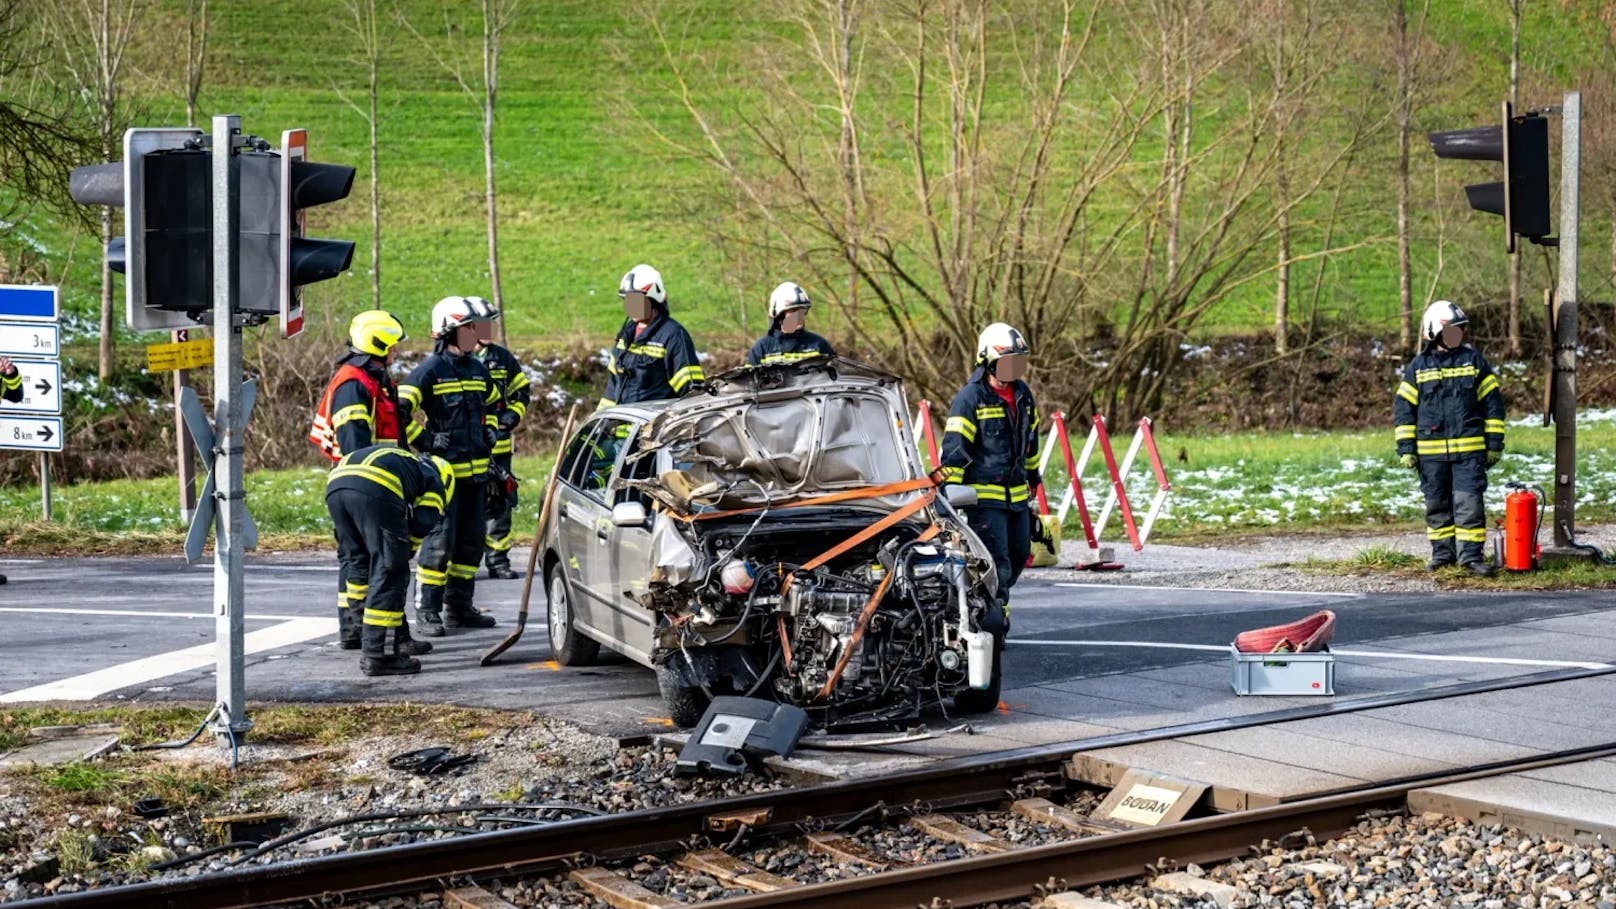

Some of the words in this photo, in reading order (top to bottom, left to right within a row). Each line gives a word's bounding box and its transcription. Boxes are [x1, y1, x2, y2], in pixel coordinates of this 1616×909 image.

[33, 334, 39, 348] 3
[40, 339, 51, 348] km
[13, 426, 20, 440] 8
[22, 431, 33, 440] km
[1121, 796, 1171, 814] BODAN
